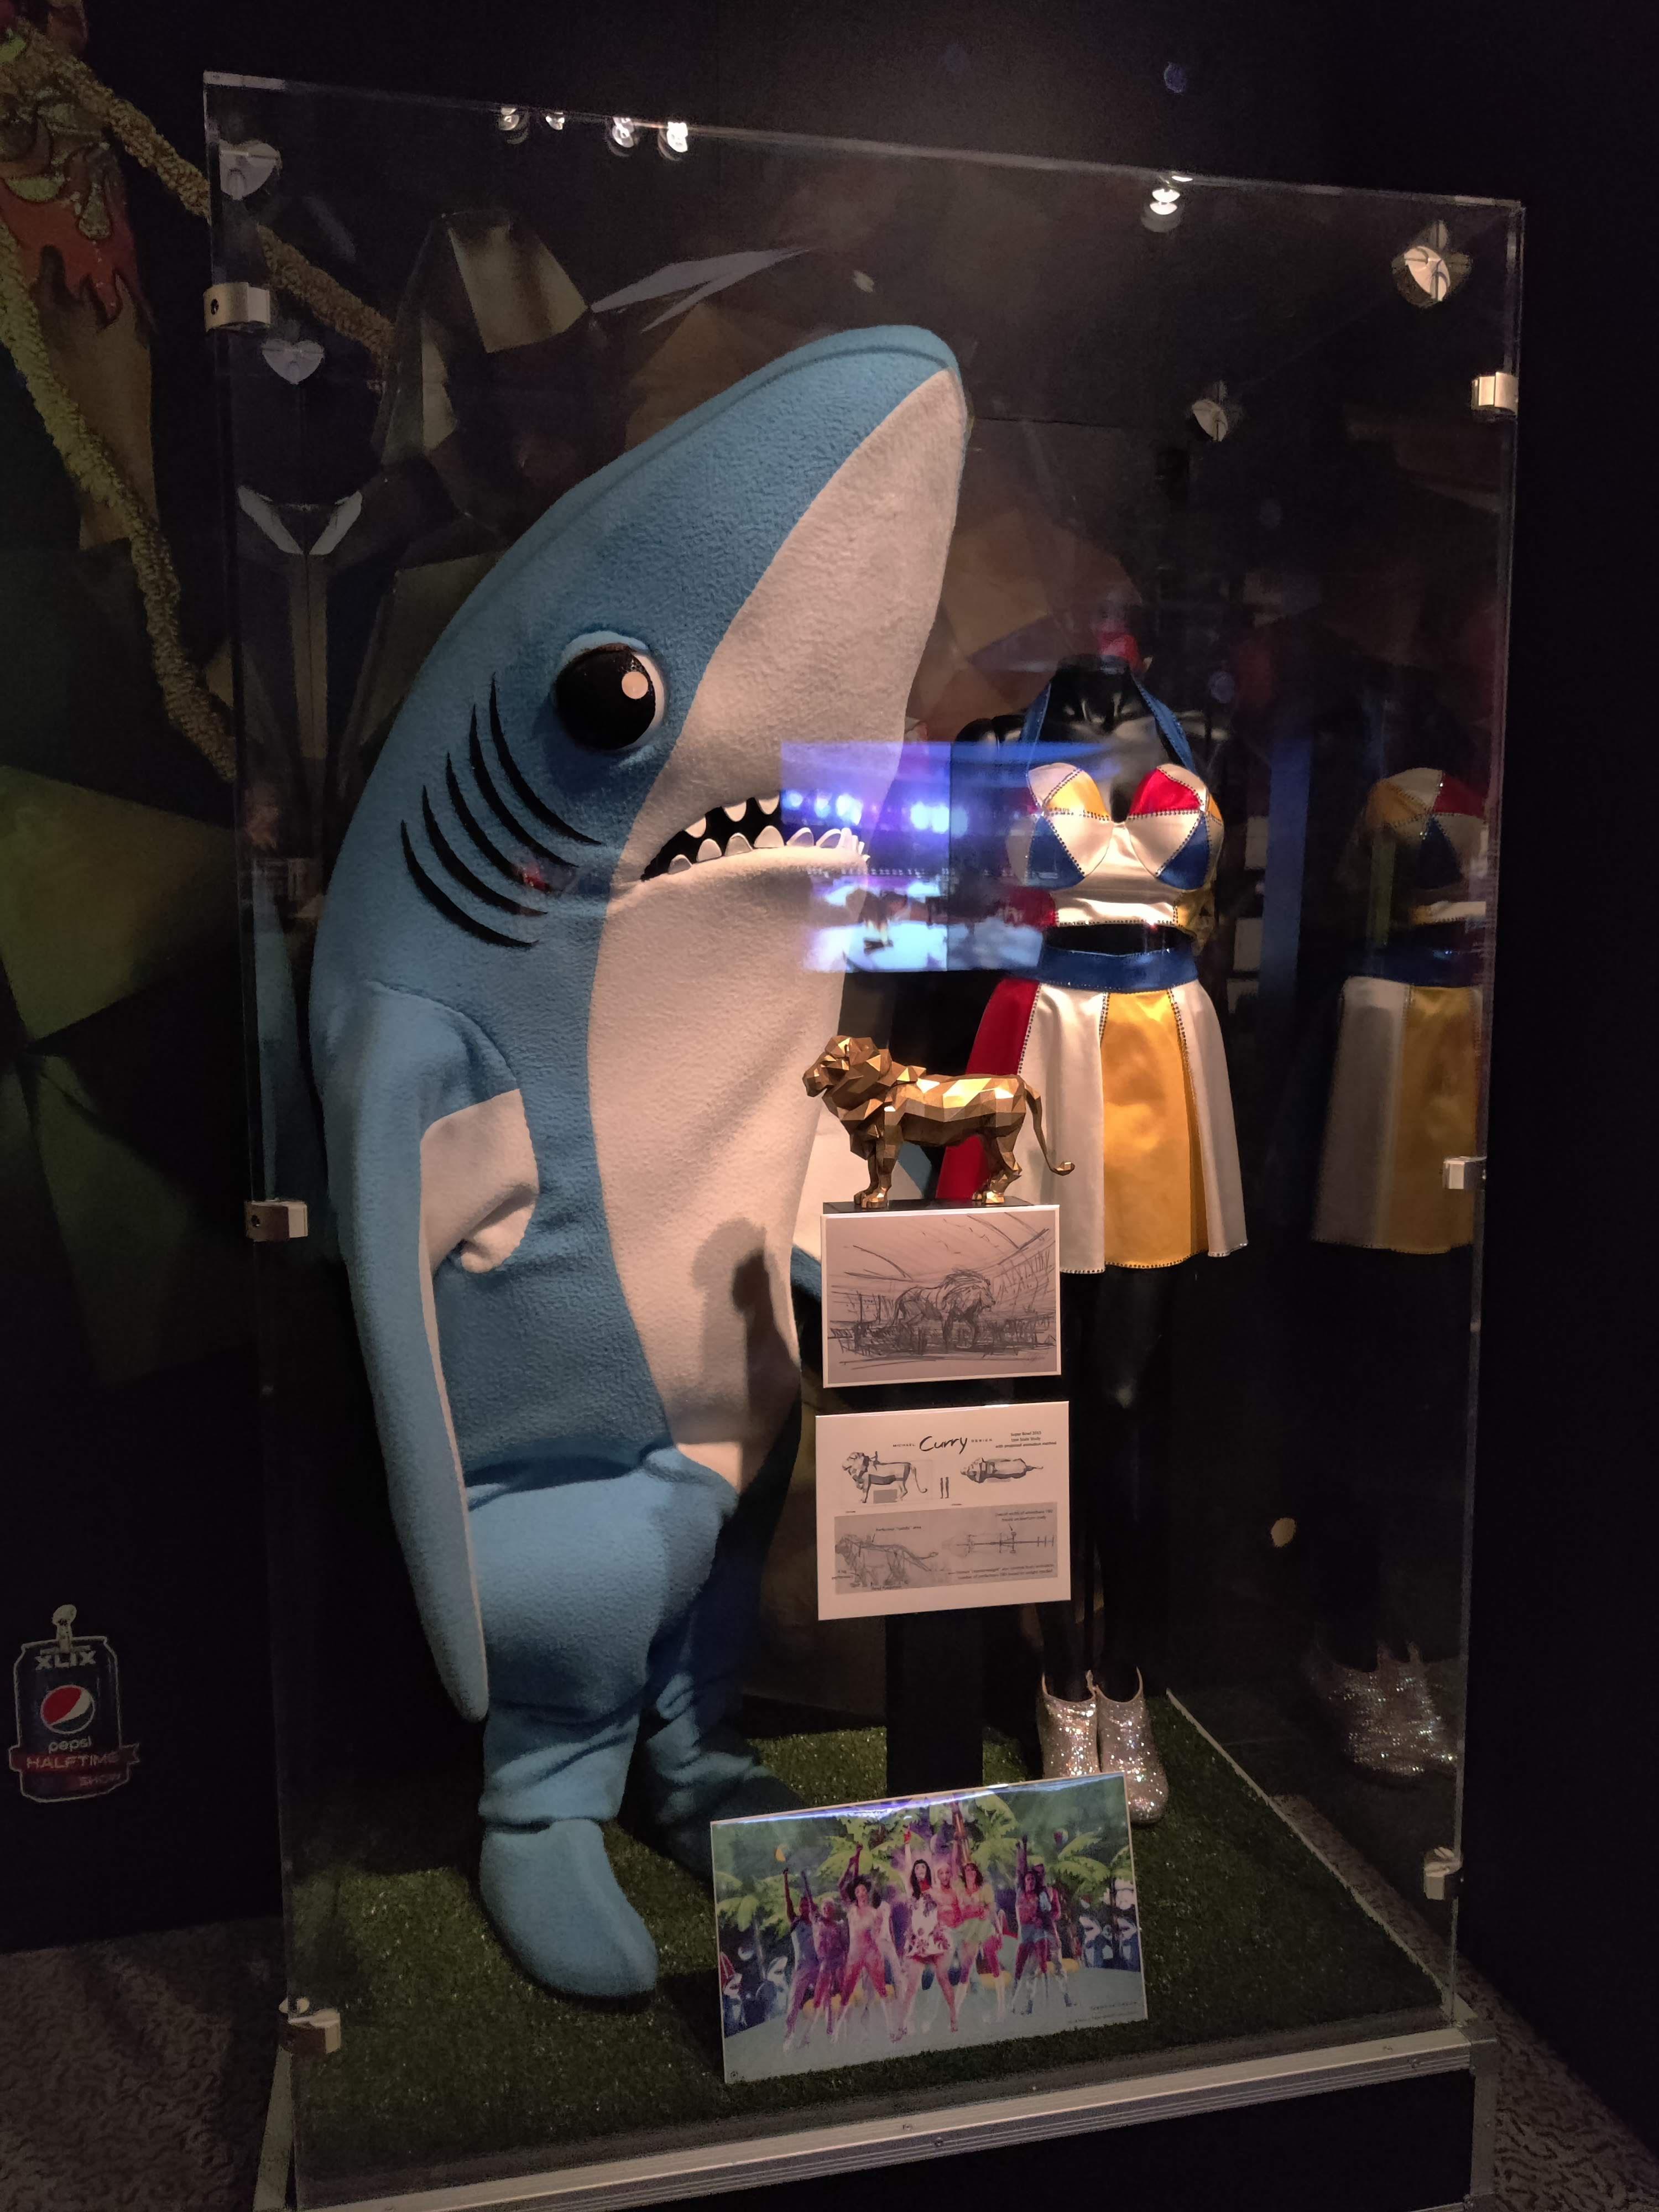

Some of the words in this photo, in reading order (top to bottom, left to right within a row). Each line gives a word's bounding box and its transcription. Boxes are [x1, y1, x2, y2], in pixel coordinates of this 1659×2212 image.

[919, 1436, 968, 1455] Curry
[34, 1650, 97, 1671] XLIX
[49, 1735, 92, 1754] pepsi
[27, 1750, 119, 1770] HALFTIME
